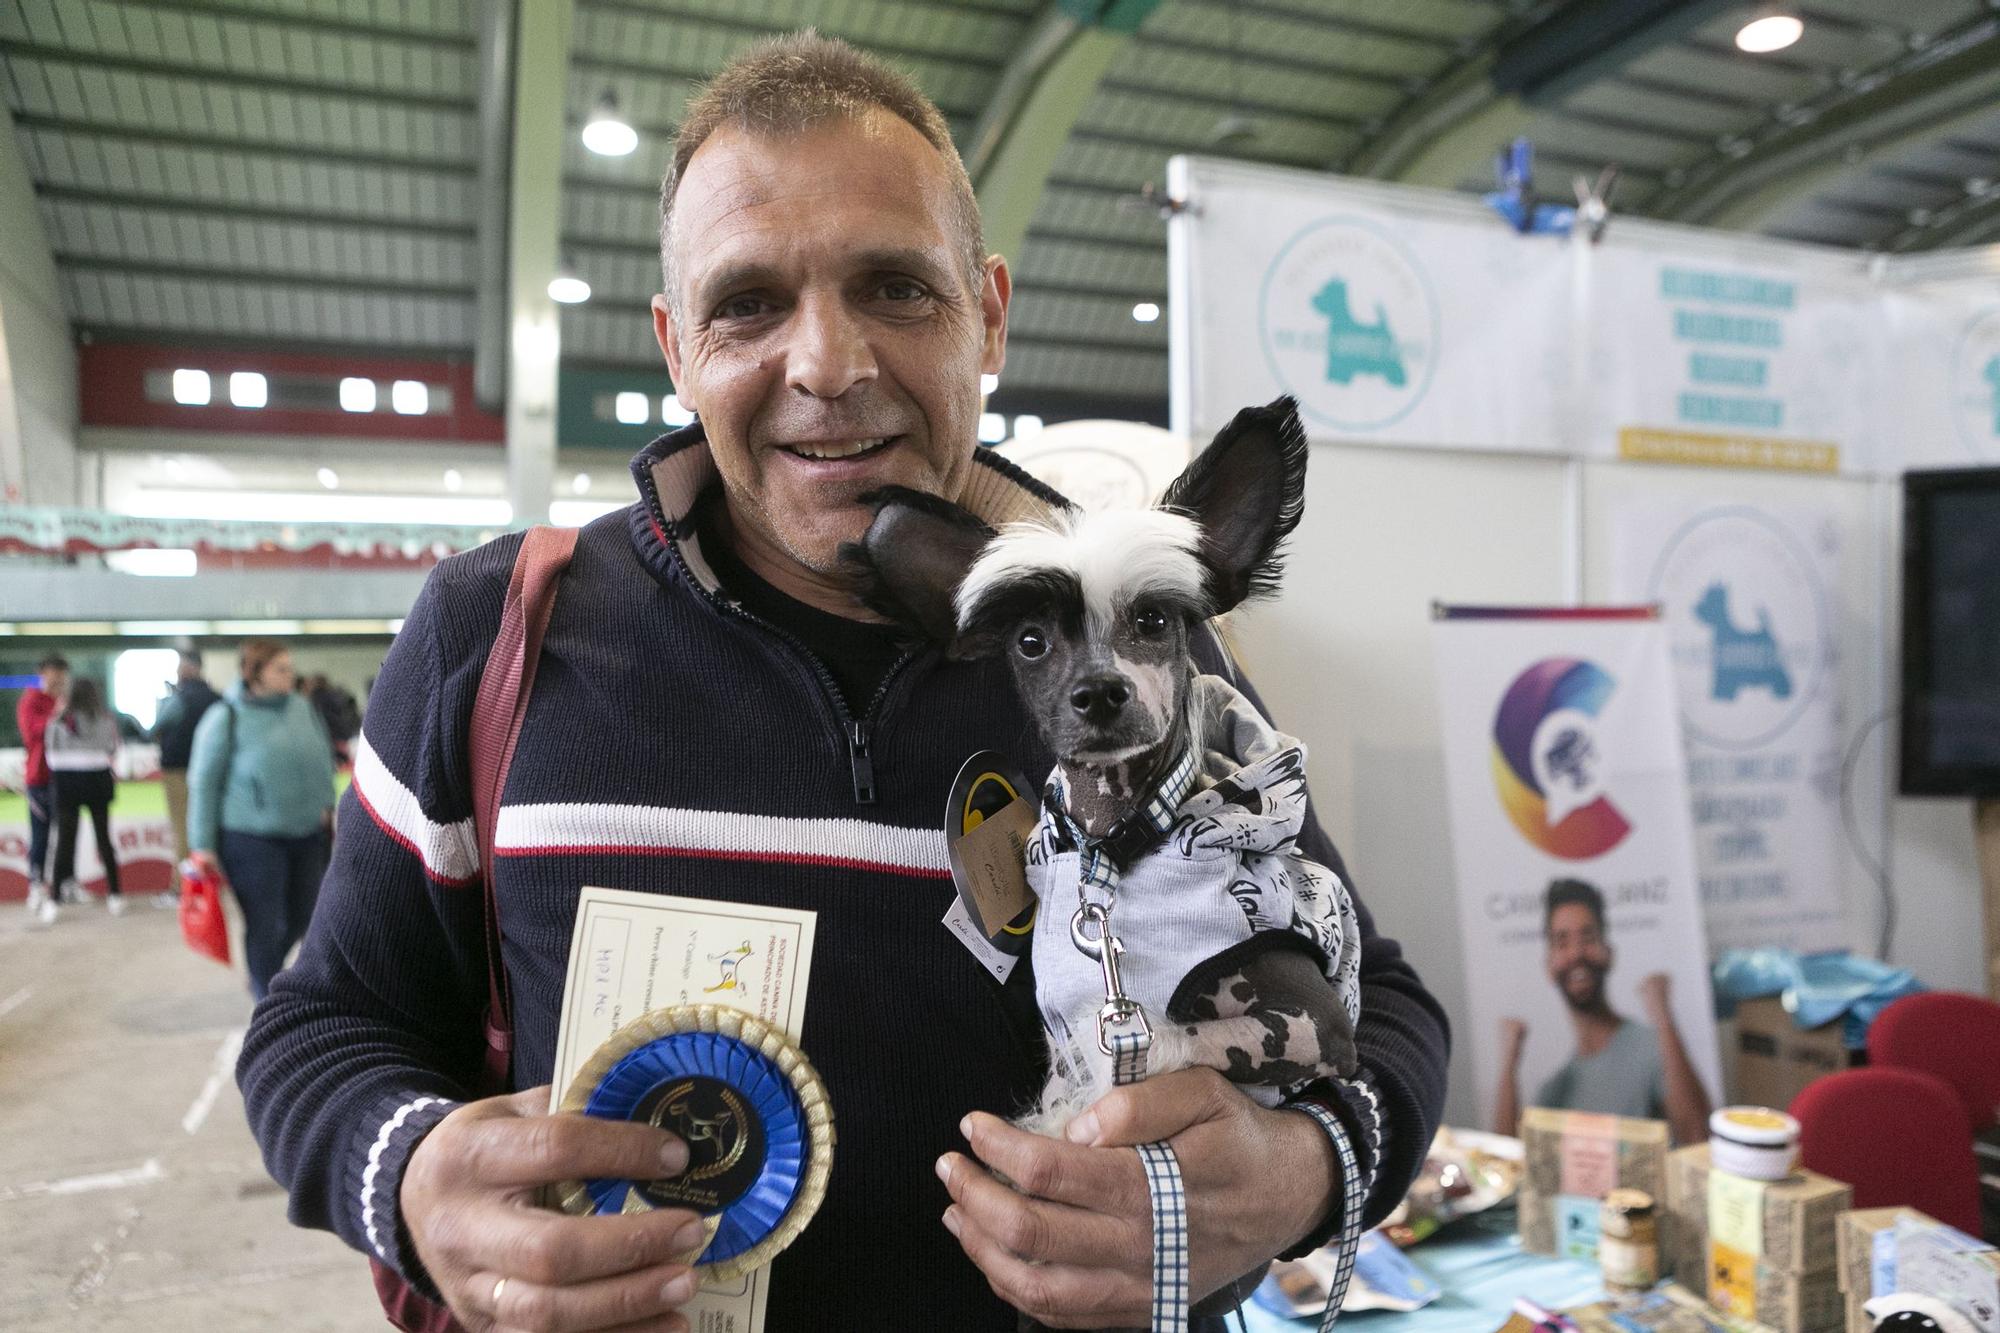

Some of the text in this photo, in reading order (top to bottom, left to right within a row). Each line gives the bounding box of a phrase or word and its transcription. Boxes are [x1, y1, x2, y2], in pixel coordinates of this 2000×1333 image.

[654, 927, 664, 951] Perro
[649, 952, 659, 977] chino
[764, 935, 777, 983] PRINCIPADO
[776, 938, 787, 979] SOCIEDAD
[761, 984, 770, 994] DE
[771, 979, 782, 1010] CANINA
